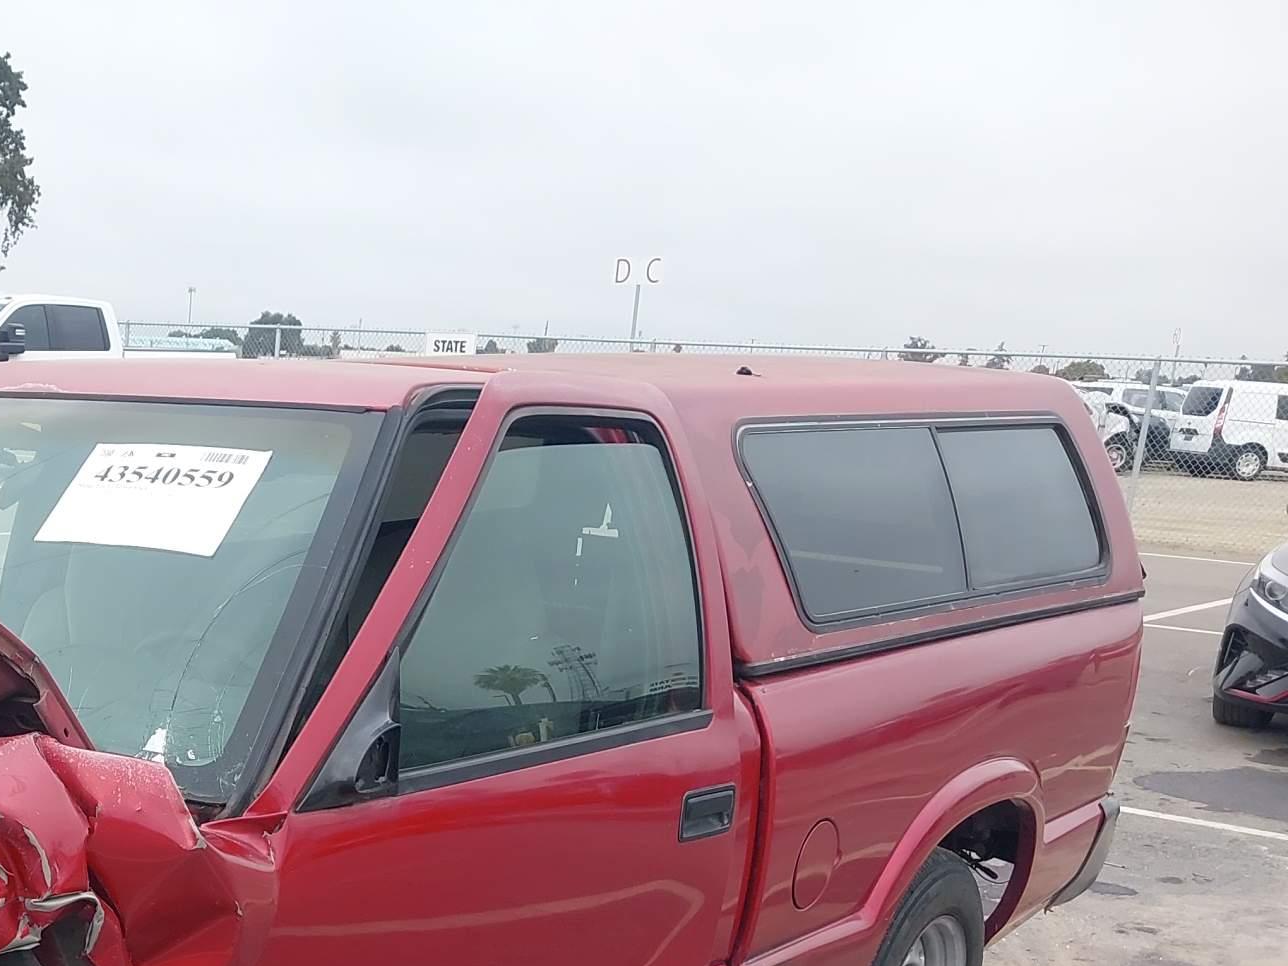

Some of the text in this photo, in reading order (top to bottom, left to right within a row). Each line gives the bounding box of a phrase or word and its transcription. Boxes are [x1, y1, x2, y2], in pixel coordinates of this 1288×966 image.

[615, 257, 662, 283] D C
[433, 339, 468, 353] STATE
[94, 464, 234, 488] 43540559
